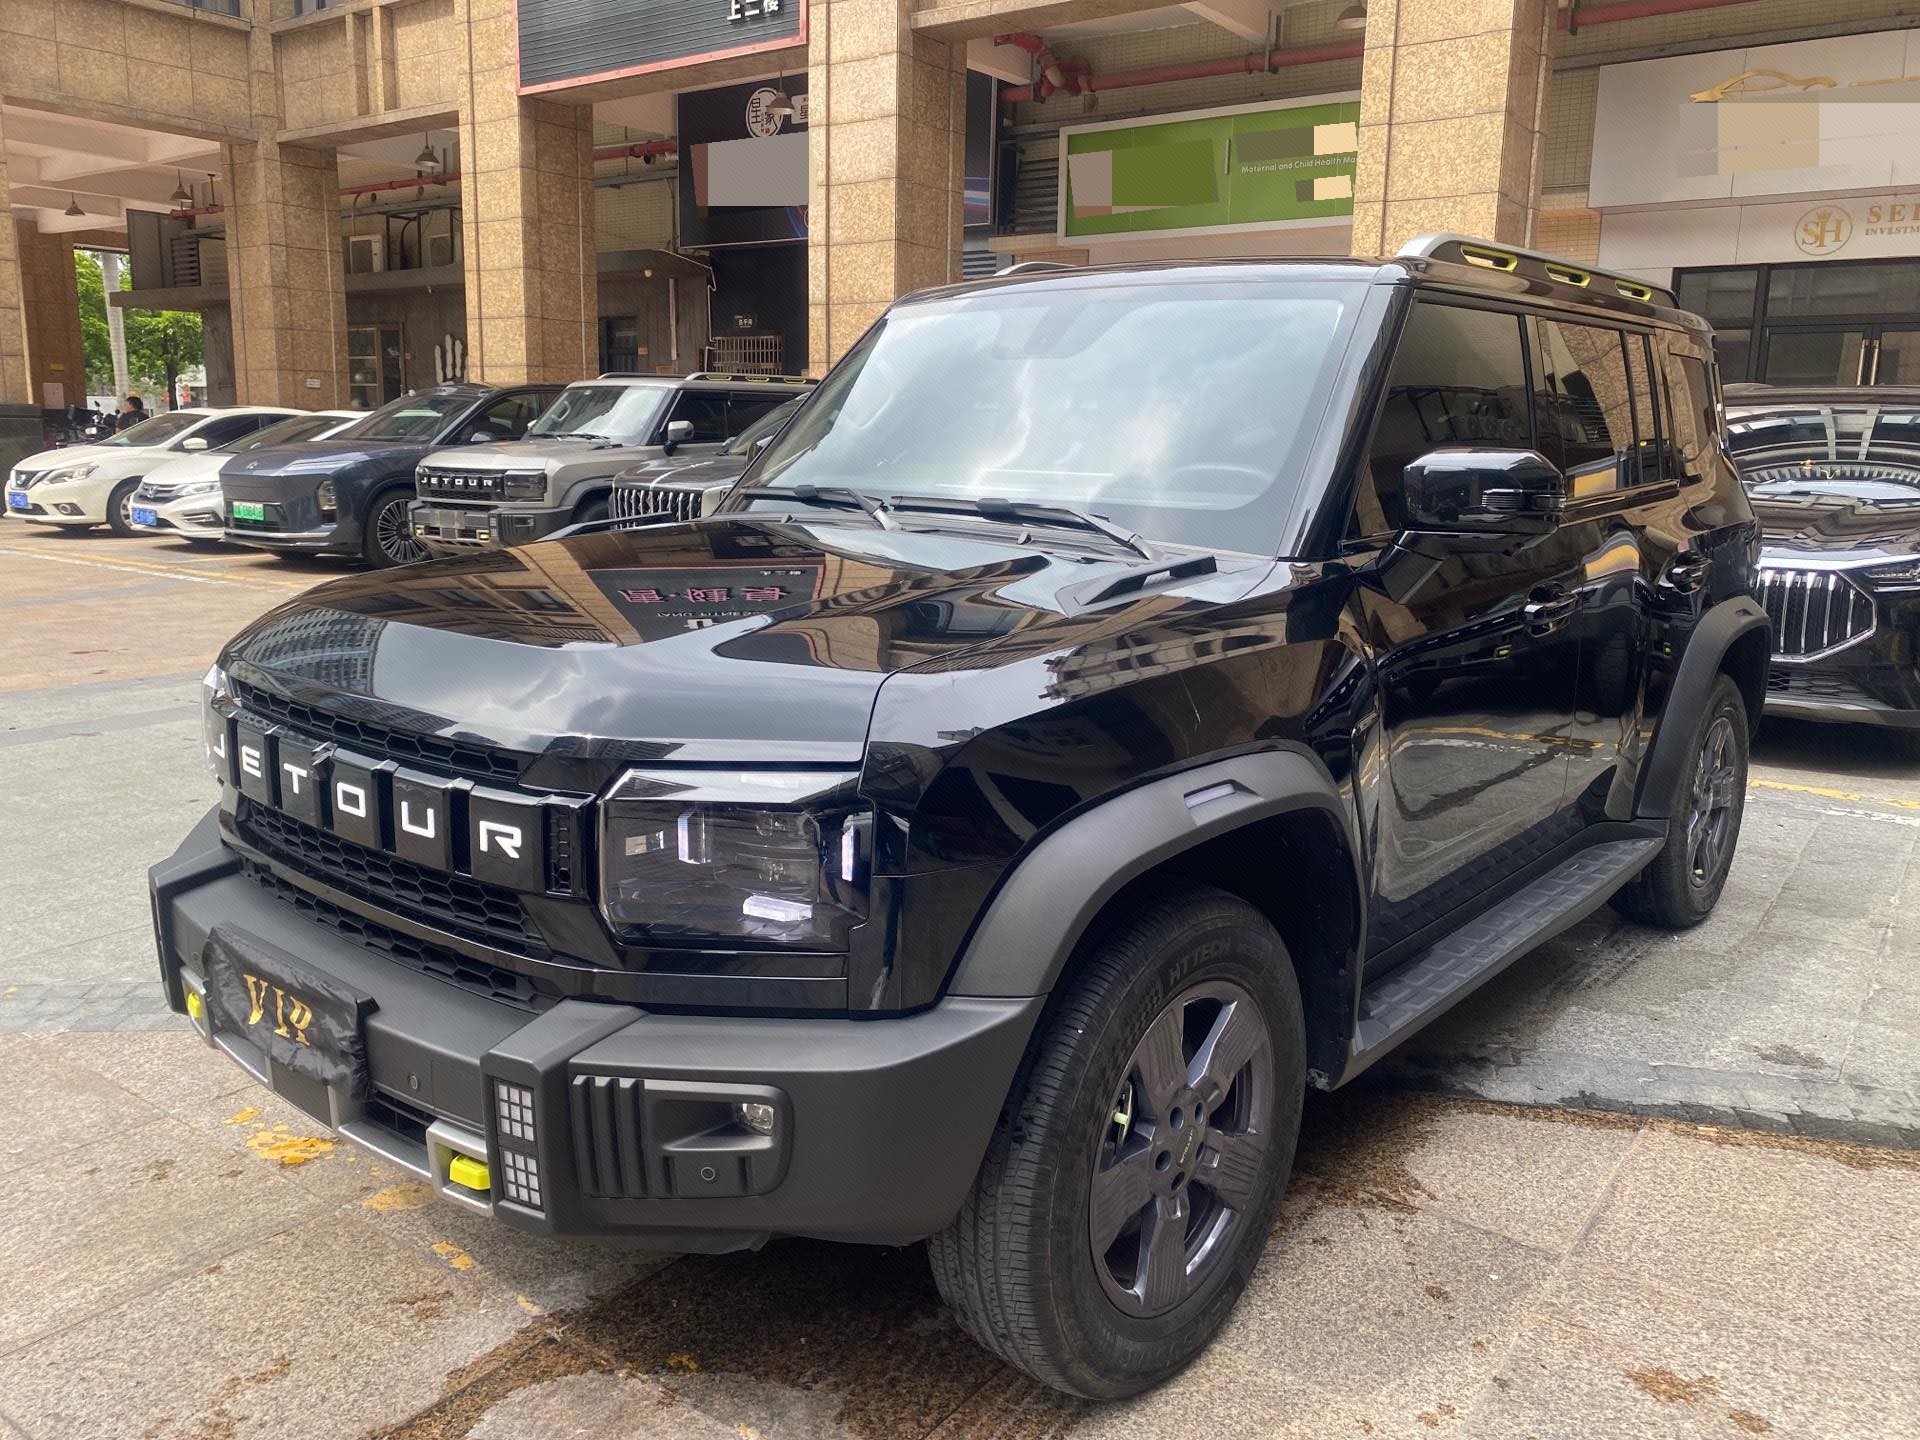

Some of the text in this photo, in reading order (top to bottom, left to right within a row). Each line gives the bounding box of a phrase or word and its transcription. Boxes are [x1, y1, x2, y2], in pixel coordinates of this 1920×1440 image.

[1241, 163, 1277, 173] Maternal
[1279, 162, 1293, 170] and
[1294, 160, 1313, 168] Child
[1314, 158, 1341, 167] Health
[420, 477, 493, 487] JETOUR
[213, 734, 522, 859] JETOUR
[243, 974, 312, 1047] VIP
